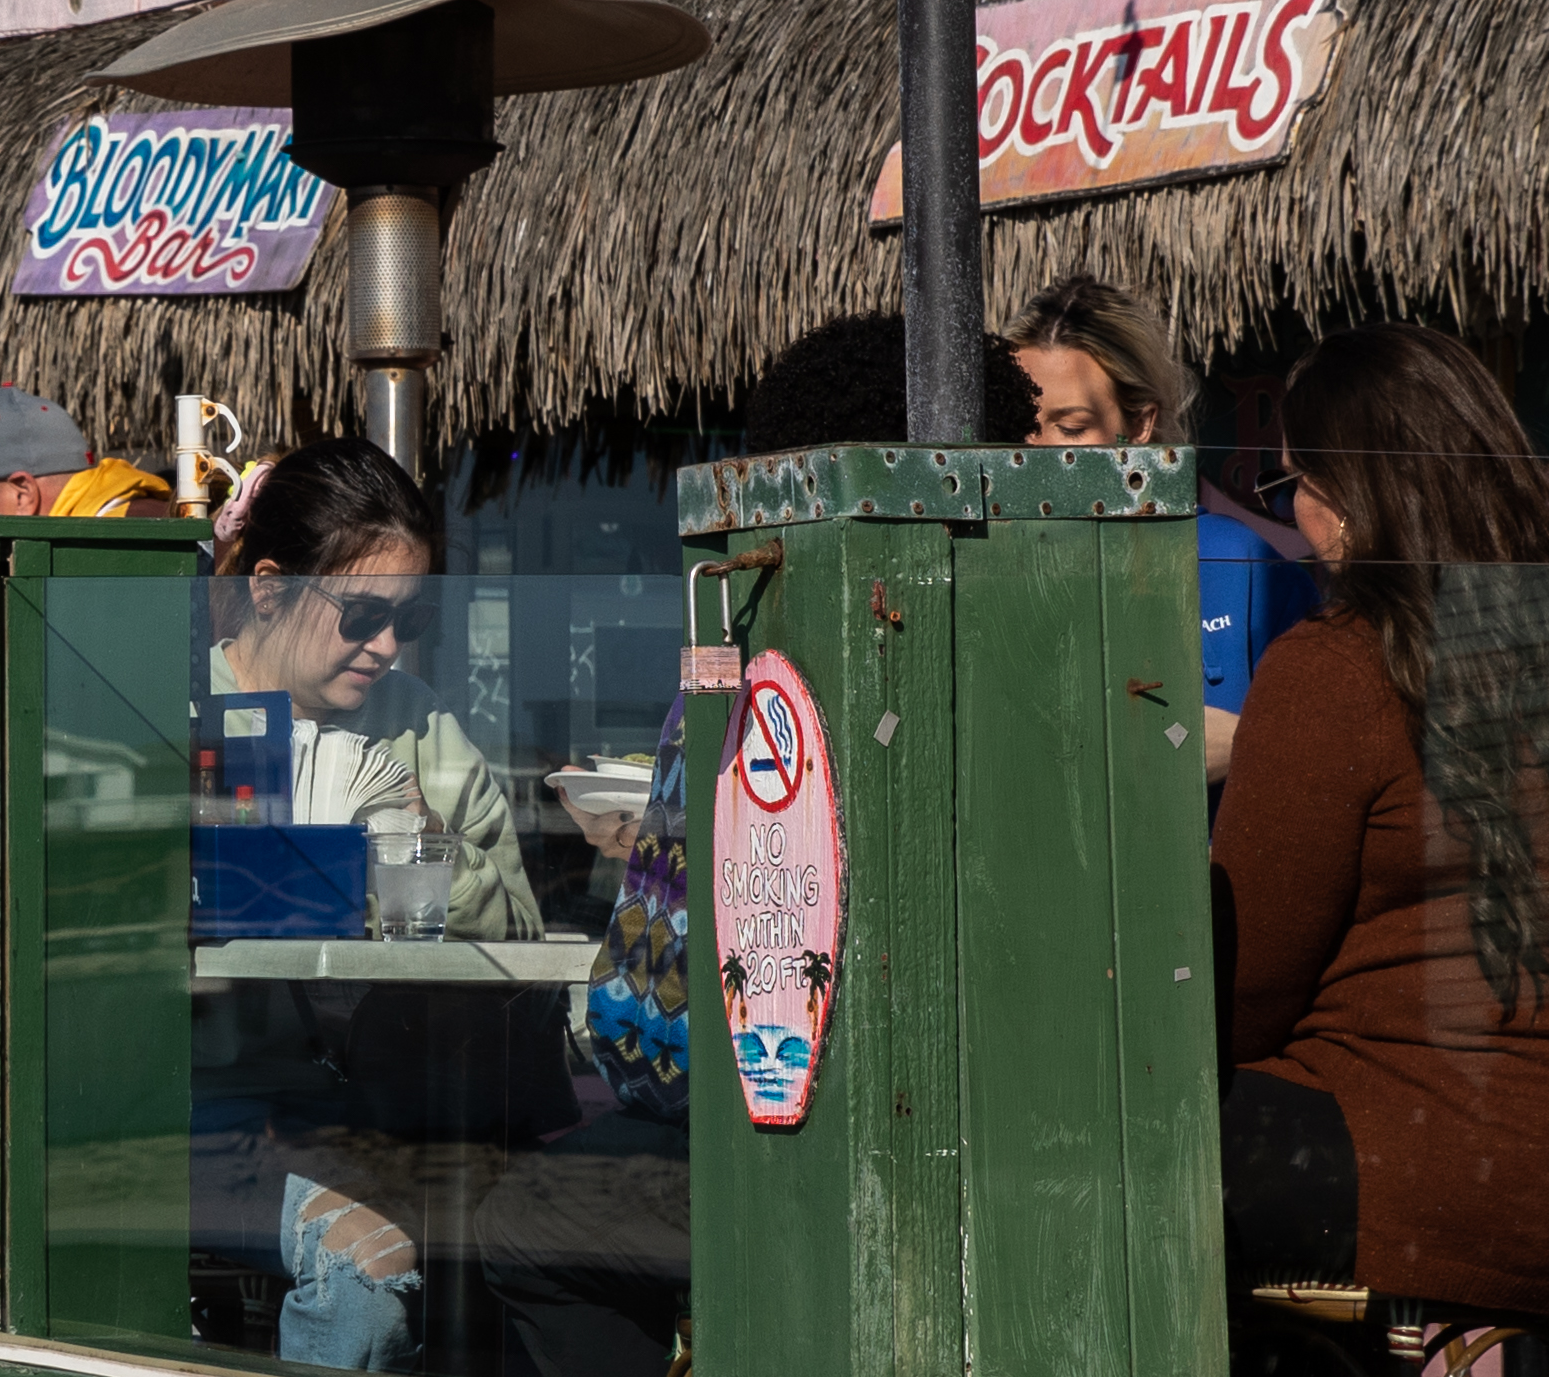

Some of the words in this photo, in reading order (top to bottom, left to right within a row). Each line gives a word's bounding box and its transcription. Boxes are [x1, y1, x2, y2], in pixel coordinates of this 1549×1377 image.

[36, 121, 238, 251] BLOODY
[65, 209, 256, 283] Bar
[1201, 615, 1232, 633] ACH
[749, 822, 786, 866] NO
[720, 858, 820, 907] SMOKING
[736, 908, 804, 954] WITHIN
[746, 949, 778, 999] 20
